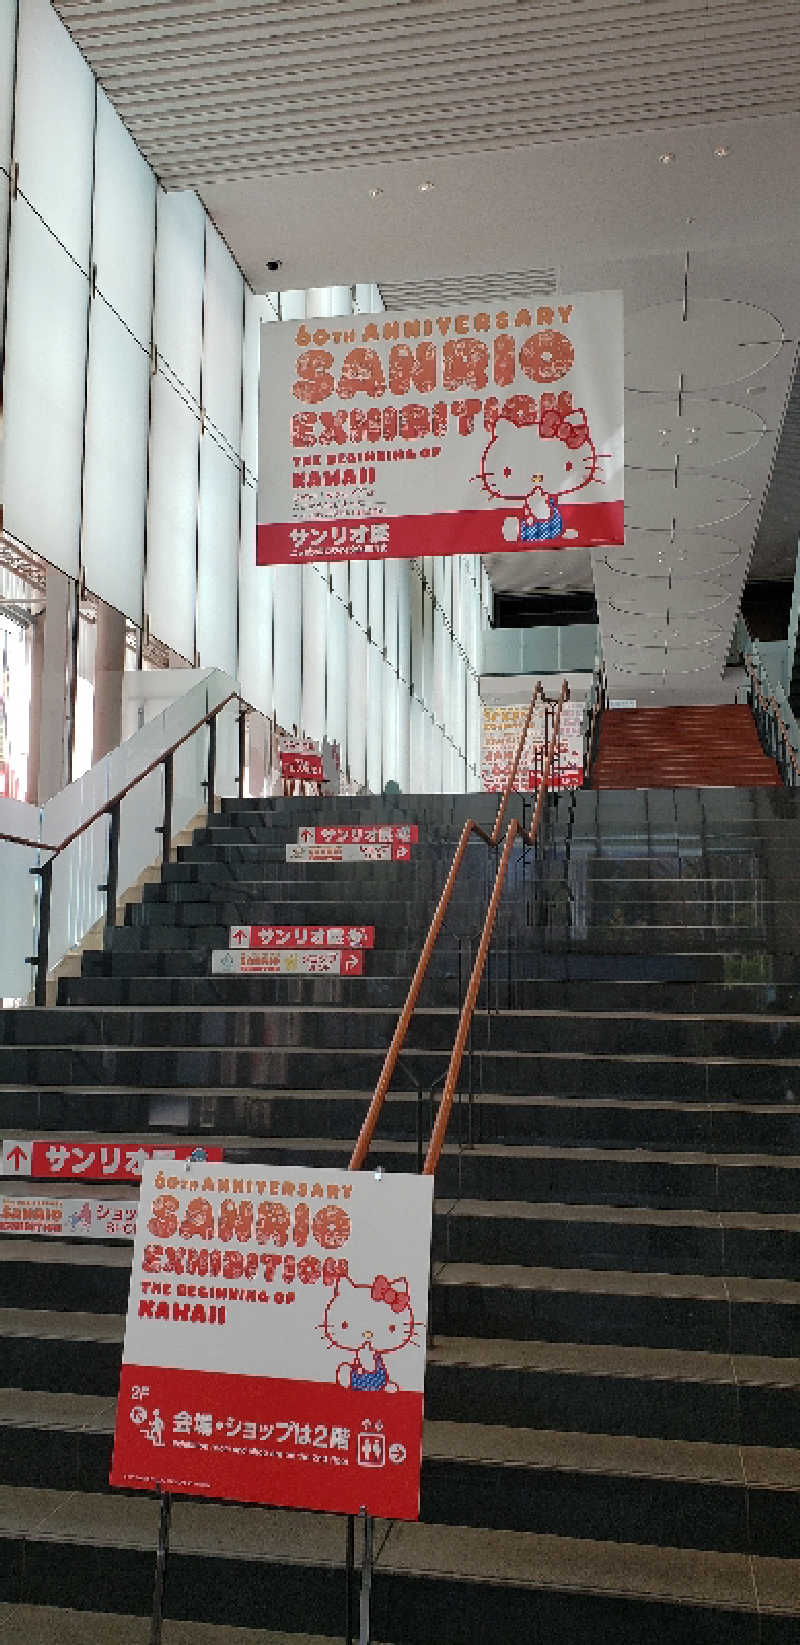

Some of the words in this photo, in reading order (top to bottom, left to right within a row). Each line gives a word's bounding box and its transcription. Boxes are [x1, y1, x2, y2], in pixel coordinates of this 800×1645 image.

[362, 305, 573, 342] ANNIVERSARY
[291, 329, 574, 404] SANRIO
[292, 454, 322, 467] THE
[326, 447, 417, 465] BEGINNING
[420, 446, 442, 458] OF
[291, 466, 376, 488] KAWAII
[289, 523, 390, 547] サンリオ展
[201, 1177, 353, 1199] ANNIVERSARY
[148, 1194, 352, 1250] SANRIO
[142, 1245, 349, 1286] EXHIBITION
[141, 1281, 172, 1296] THE
[176, 1284, 269, 1304] BEGINNING
[273, 1291, 296, 1305] OF
[138, 1299, 226, 1326] KAWAII
[131, 1385, 150, 1400] 2F
